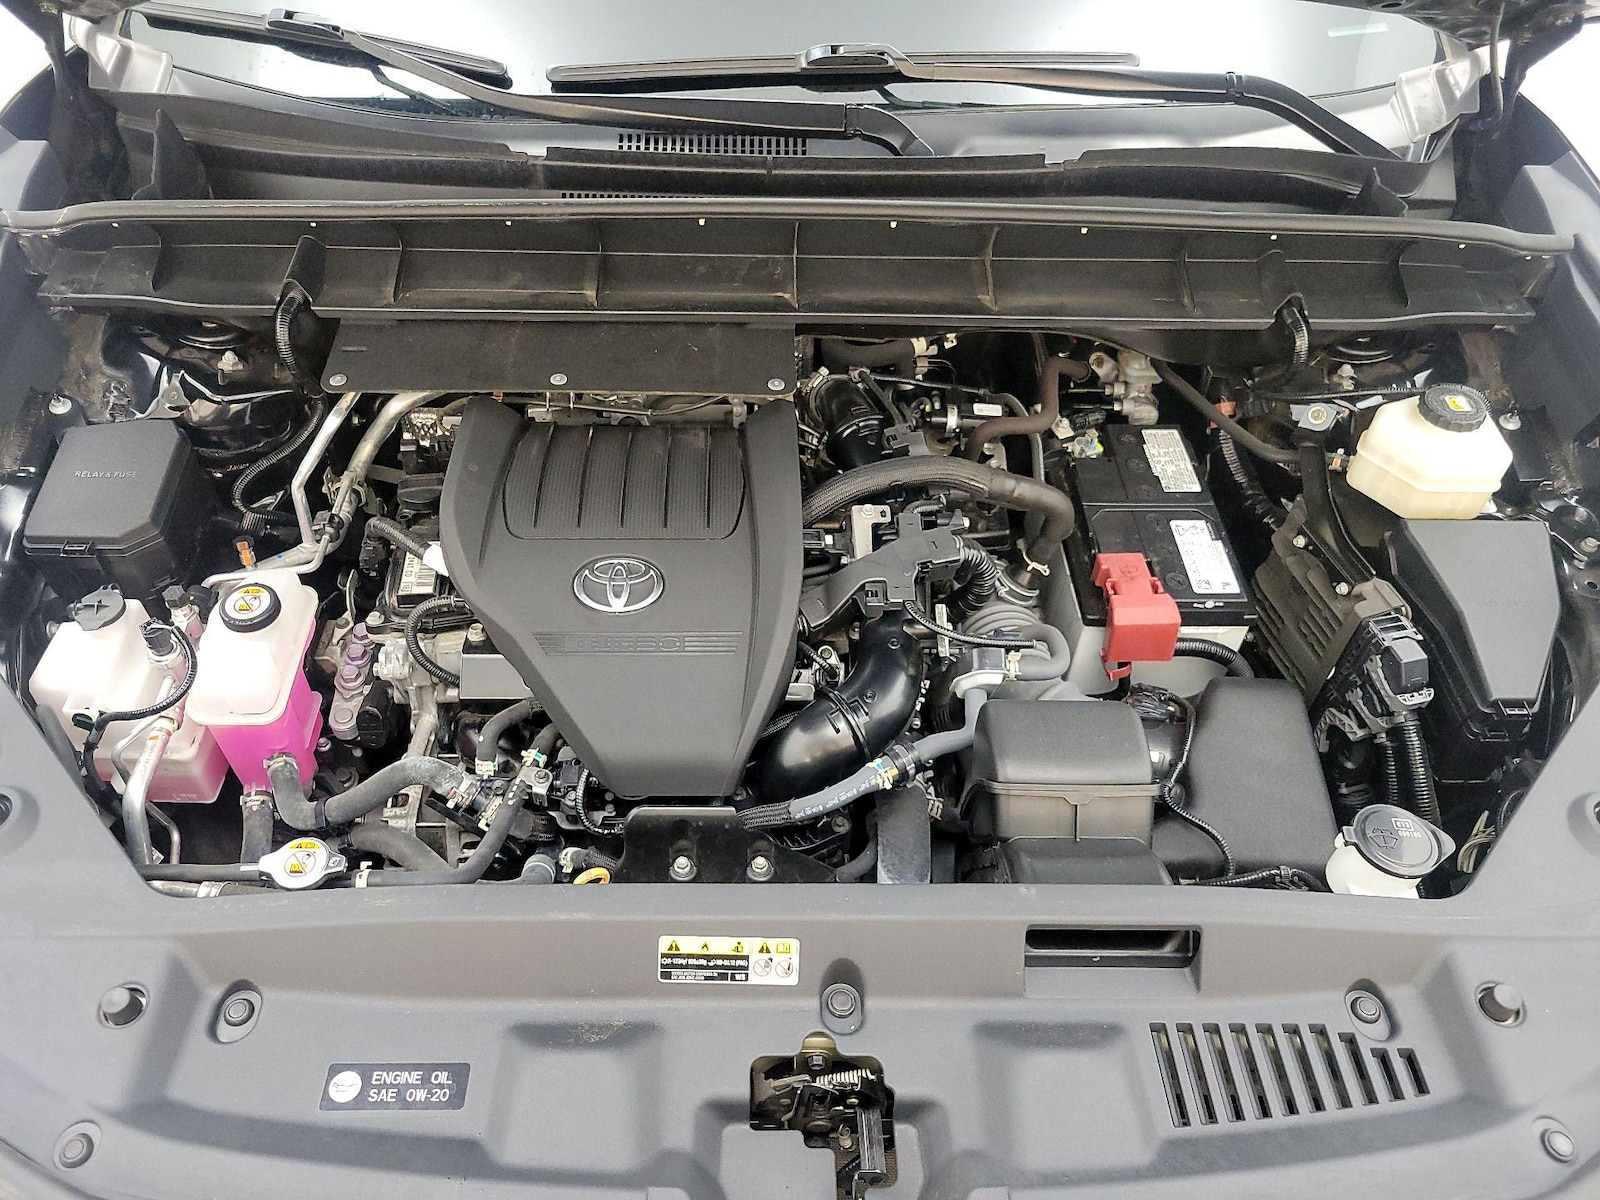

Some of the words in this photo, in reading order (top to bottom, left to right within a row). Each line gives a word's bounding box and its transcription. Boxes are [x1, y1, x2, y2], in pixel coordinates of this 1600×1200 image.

[75, 470, 104, 478] RELAY
[569, 636, 681, 651] TURBO
[371, 1071, 423, 1084] ENGINE
[430, 1071, 453, 1084] OIL
[368, 1088, 398, 1102] SAE
[406, 1088, 450, 1102] 0W-20
